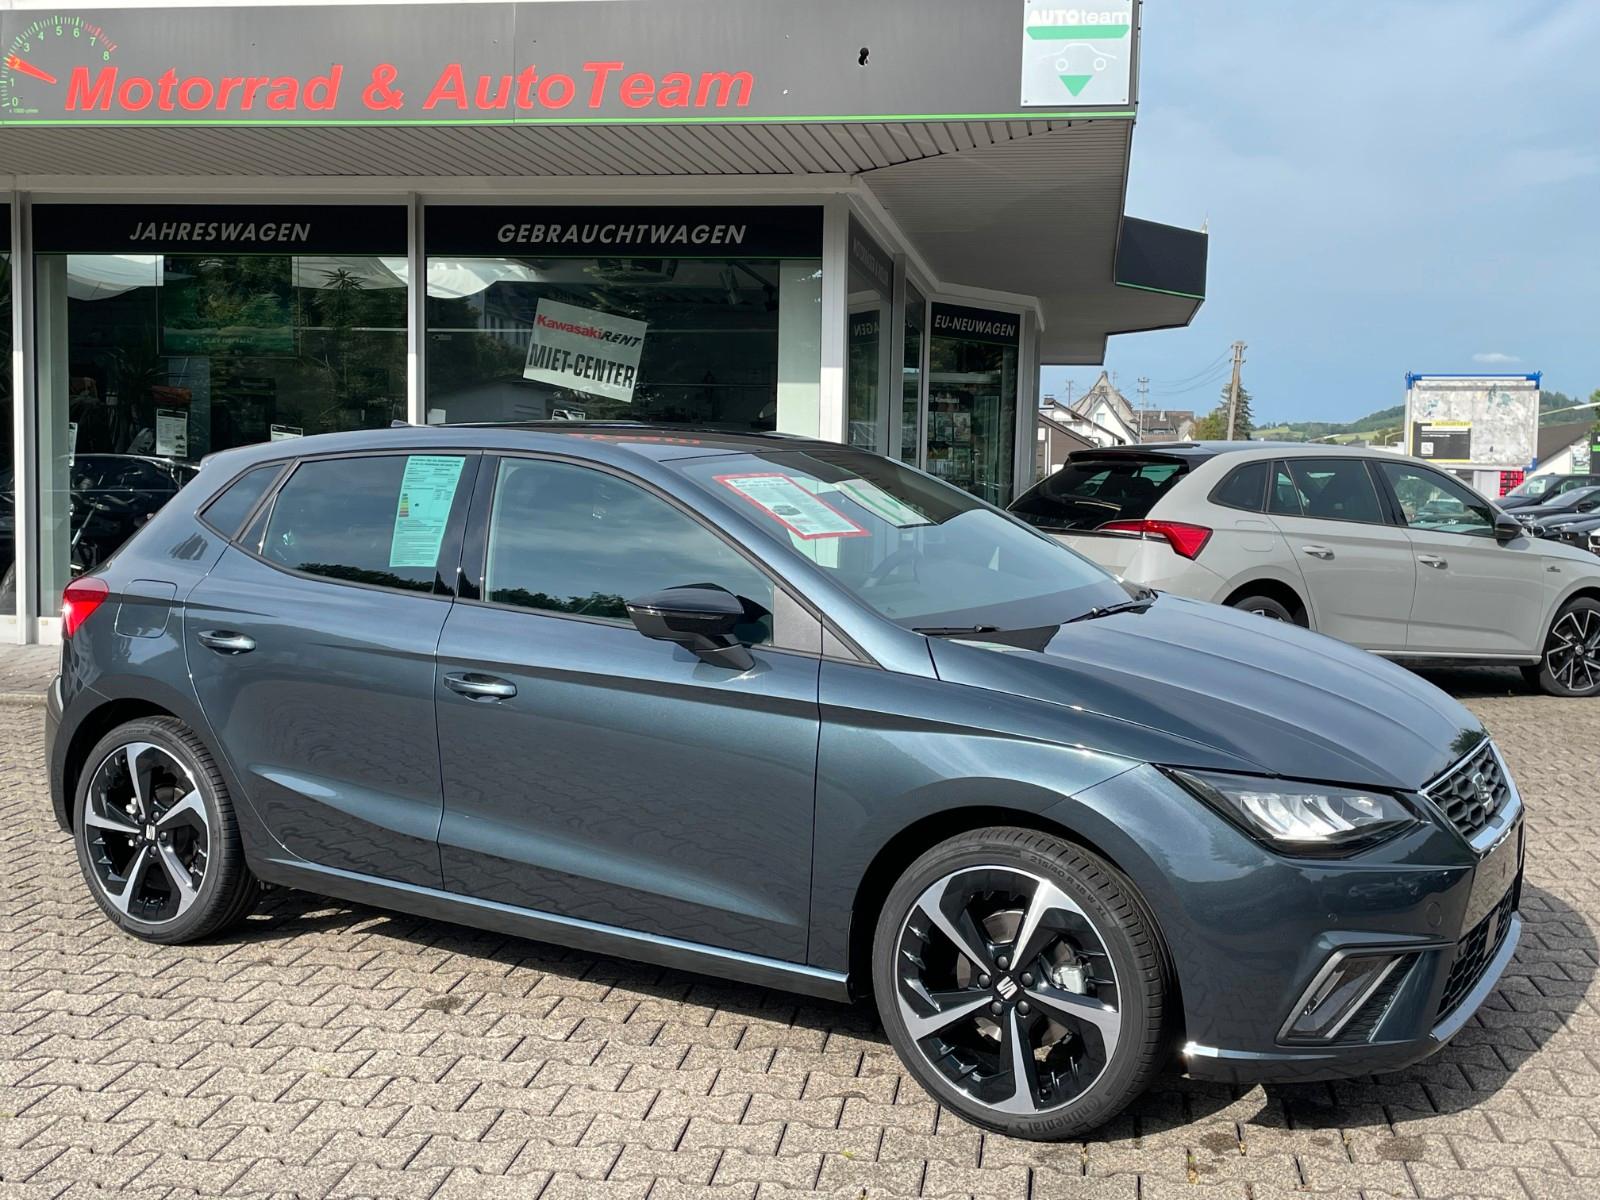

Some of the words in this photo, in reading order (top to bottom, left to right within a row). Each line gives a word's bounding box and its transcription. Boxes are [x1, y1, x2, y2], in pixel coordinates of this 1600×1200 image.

[1028, 9, 1129, 24] AUTOteam
[56, 26, 63, 36] 5
[73, 28, 80, 38] 6
[90, 37, 96, 47] 7
[103, 51, 110, 61] 8
[65, 64, 343, 111] Motorrad
[361, 63, 404, 111] &
[129, 222, 311, 241] JAHRESWAGEN
[497, 223, 746, 244] GEBRAUCHTWAGEN
[934, 314, 1016, 337] EU-NEUWAGEN
[528, 343, 636, 389] MIET-CENTER
